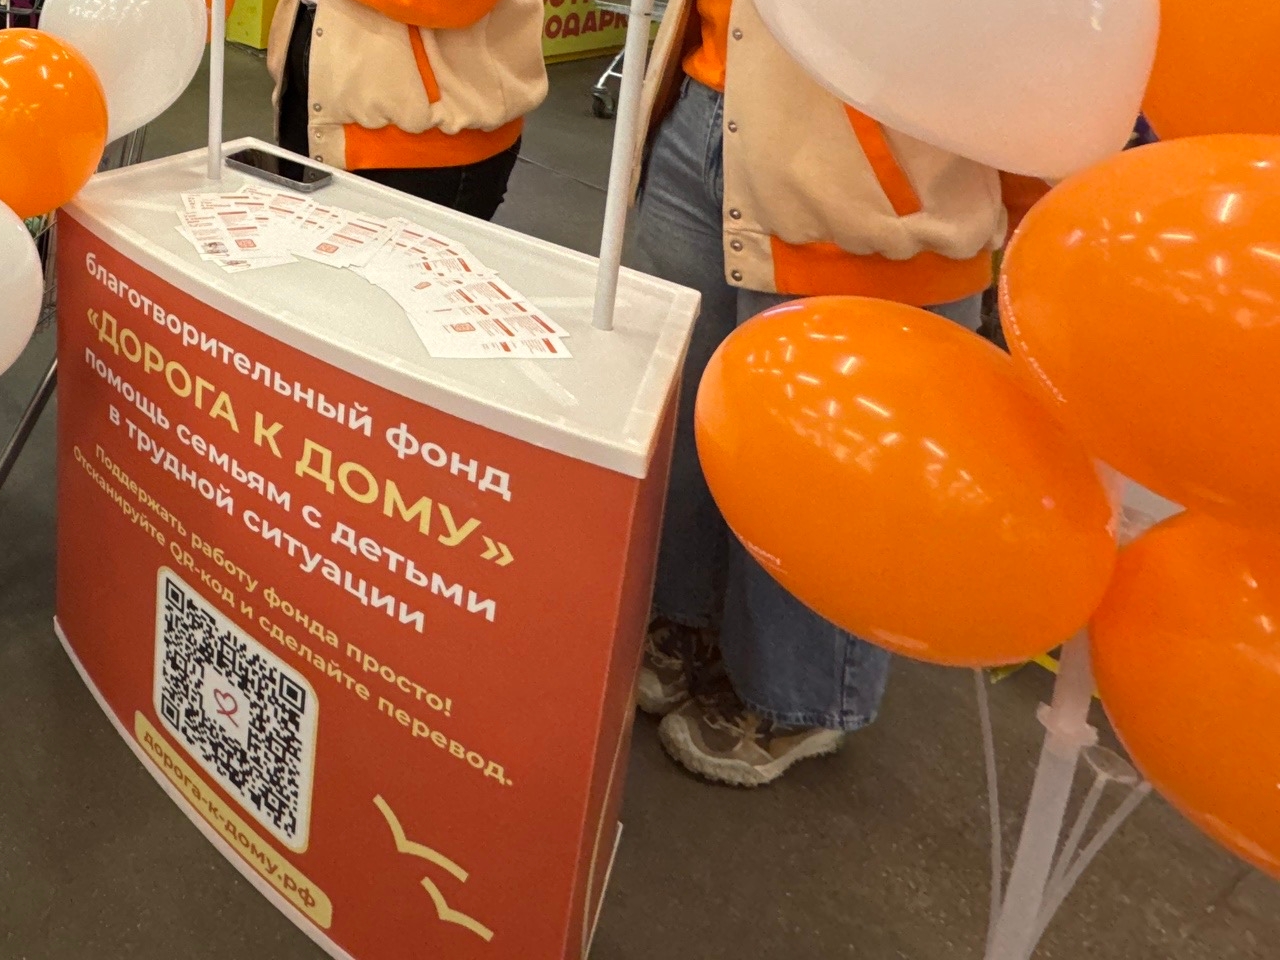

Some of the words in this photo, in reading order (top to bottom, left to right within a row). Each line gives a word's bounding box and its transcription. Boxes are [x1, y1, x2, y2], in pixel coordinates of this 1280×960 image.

[544, 9, 629, 39] ОДАРК
[84, 251, 373, 438] благотворительный
[385, 422, 513, 502] фонд
[84, 346, 170, 431] помощь
[177, 421, 291, 513] семьям
[302, 503, 322, 528] с
[330, 520, 498, 623] детьми
[86, 306, 240, 434] «ДОРОГА
[253, 411, 285, 459] К
[295, 438, 516, 568] ДОМУ»
[72, 444, 166, 548] Отсканируйте
[169, 544, 236, 609] QR-код
[240, 601, 253, 620] и
[258, 615, 370, 702] сделайте
[378, 698, 515, 786] перевод.
[94, 443, 187, 538] Поддержать
[191, 530, 259, 593] работу
[263, 586, 339, 648] фонда
[346, 644, 453, 719] просто!
[108, 404, 121, 427] в
[125, 417, 234, 517] трудной
[243, 508, 426, 634] ситуации
[143, 729, 317, 910] дорога-к-дому.рф
